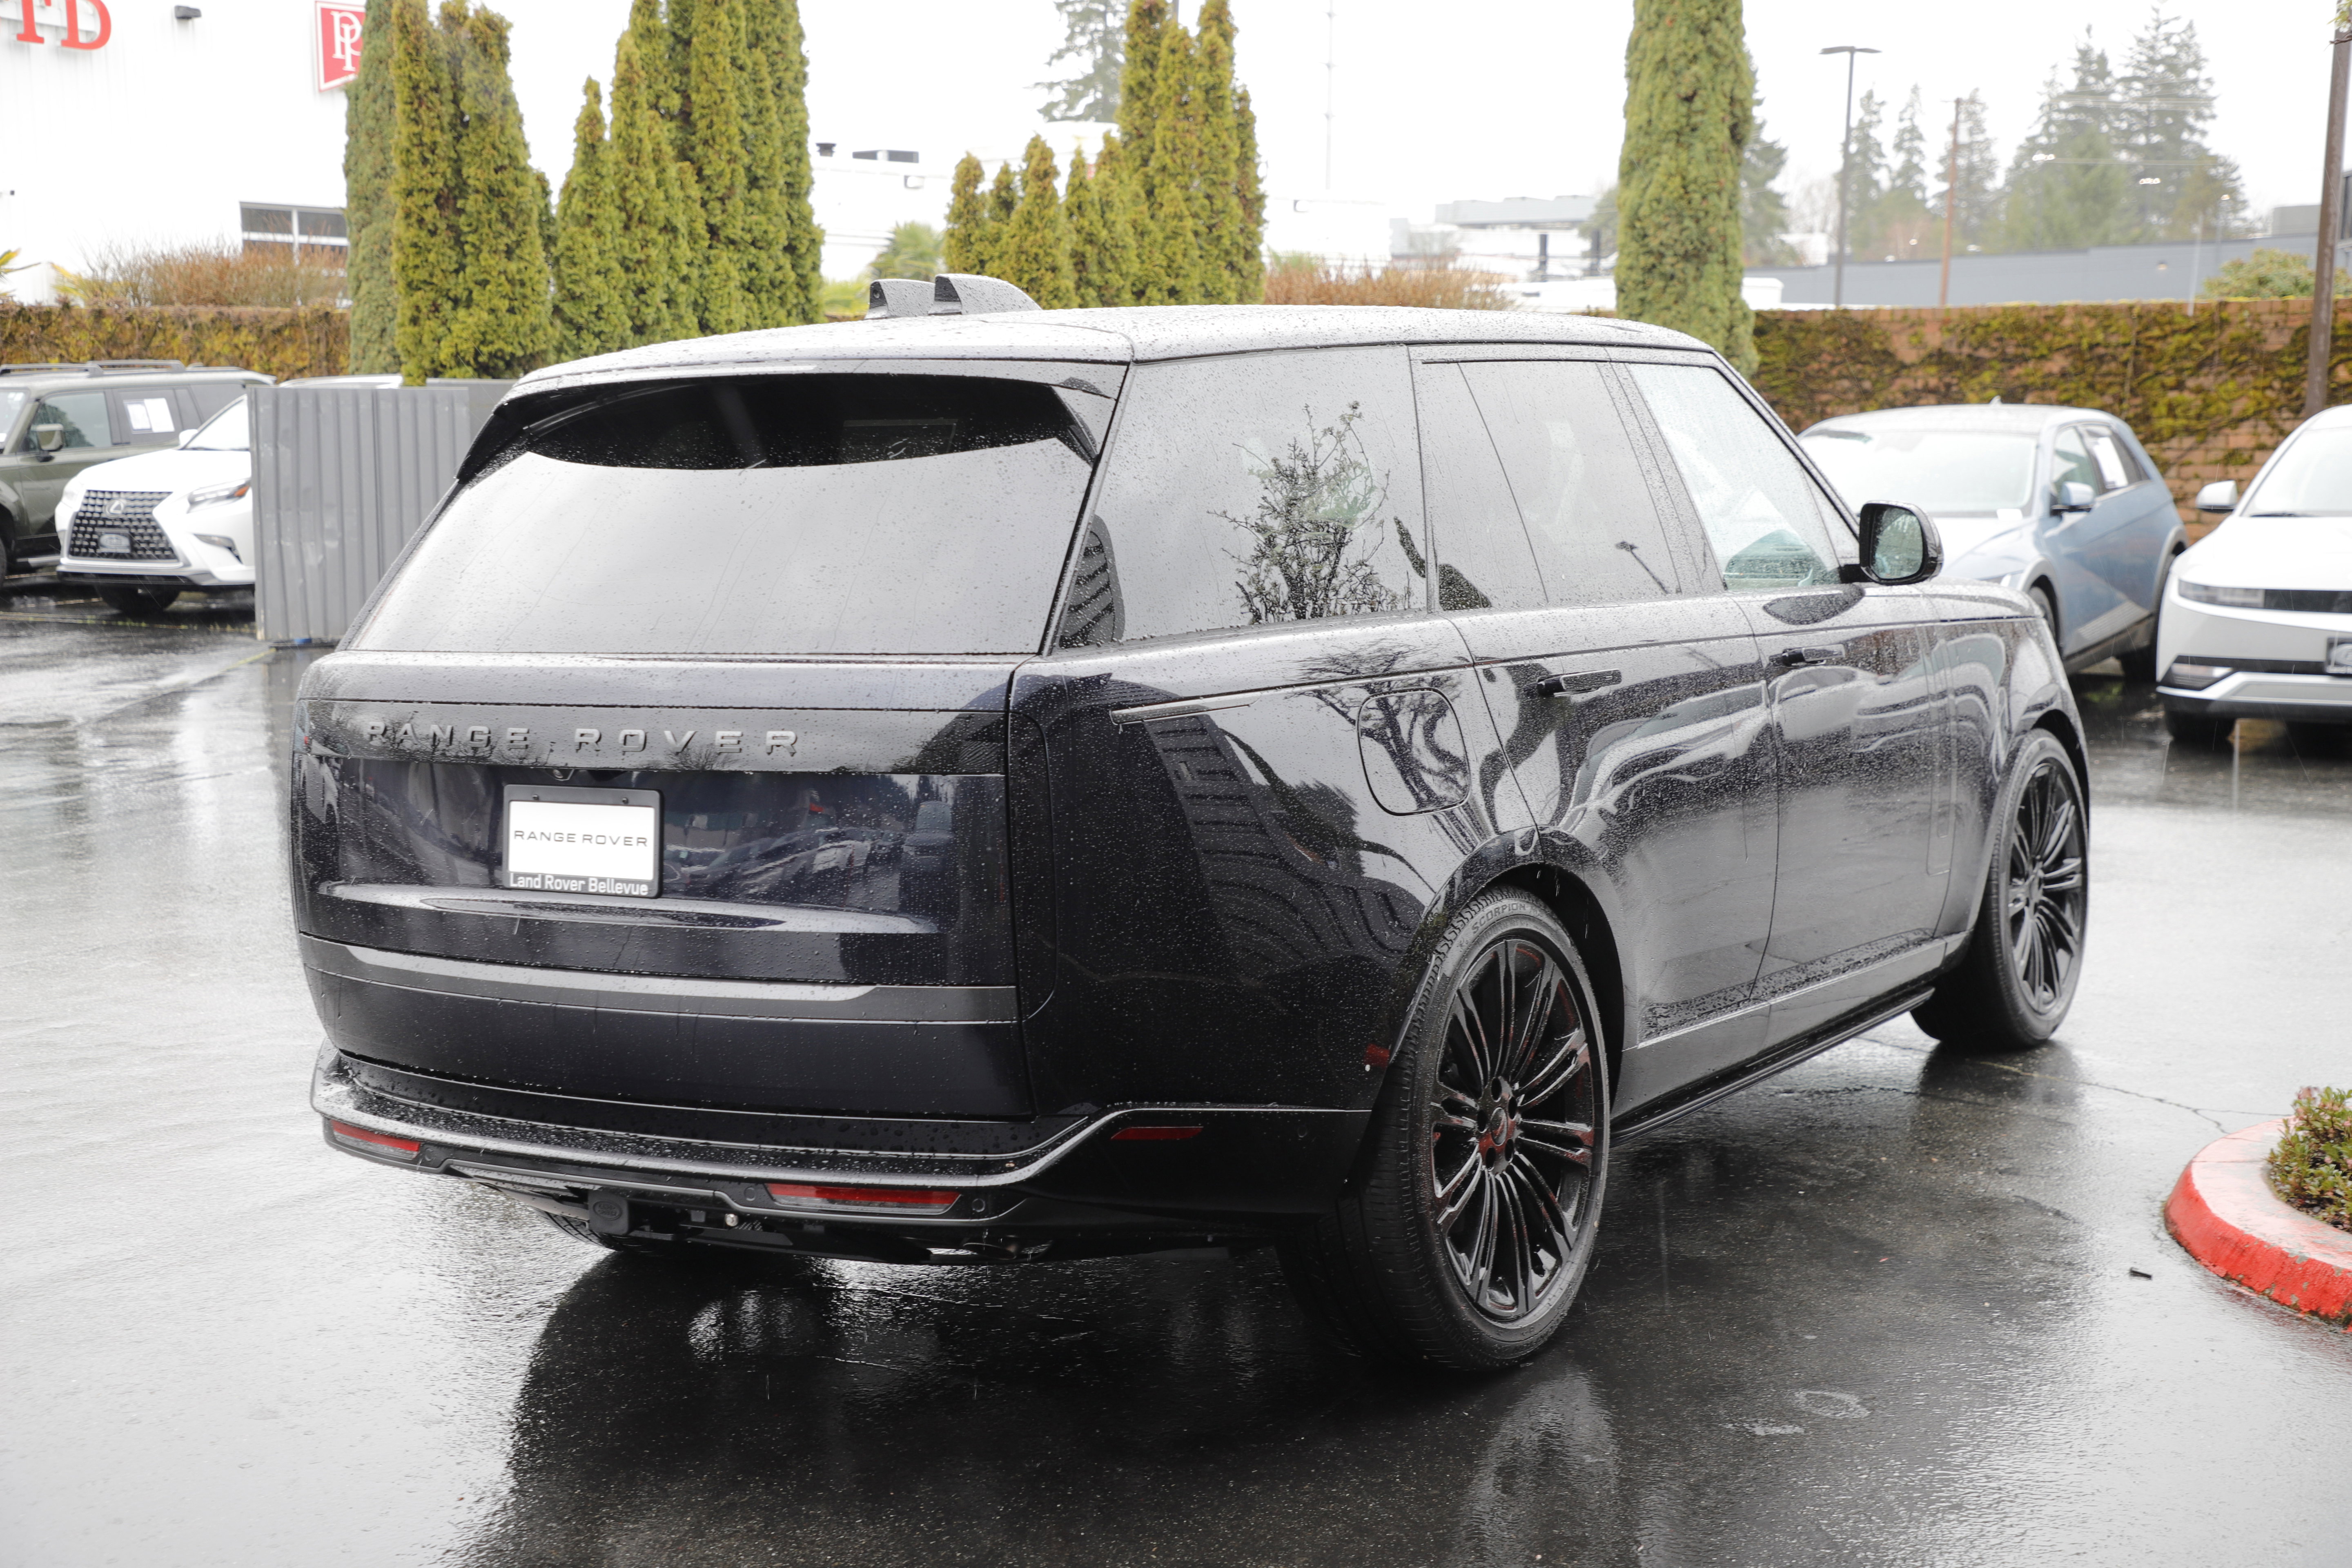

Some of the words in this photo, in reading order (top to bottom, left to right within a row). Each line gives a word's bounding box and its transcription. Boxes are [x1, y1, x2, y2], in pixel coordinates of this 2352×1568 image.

[365, 721, 530, 750] RANGE
[574, 728, 798, 757] ROVER
[514, 830, 576, 843] RANGE
[582, 834, 648, 847] ROVER
[510, 873, 542, 889] Land
[545, 875, 586, 891] Rover
[588, 878, 648, 896] Bellevue
[1472, 903, 1526, 934] SCORPION
